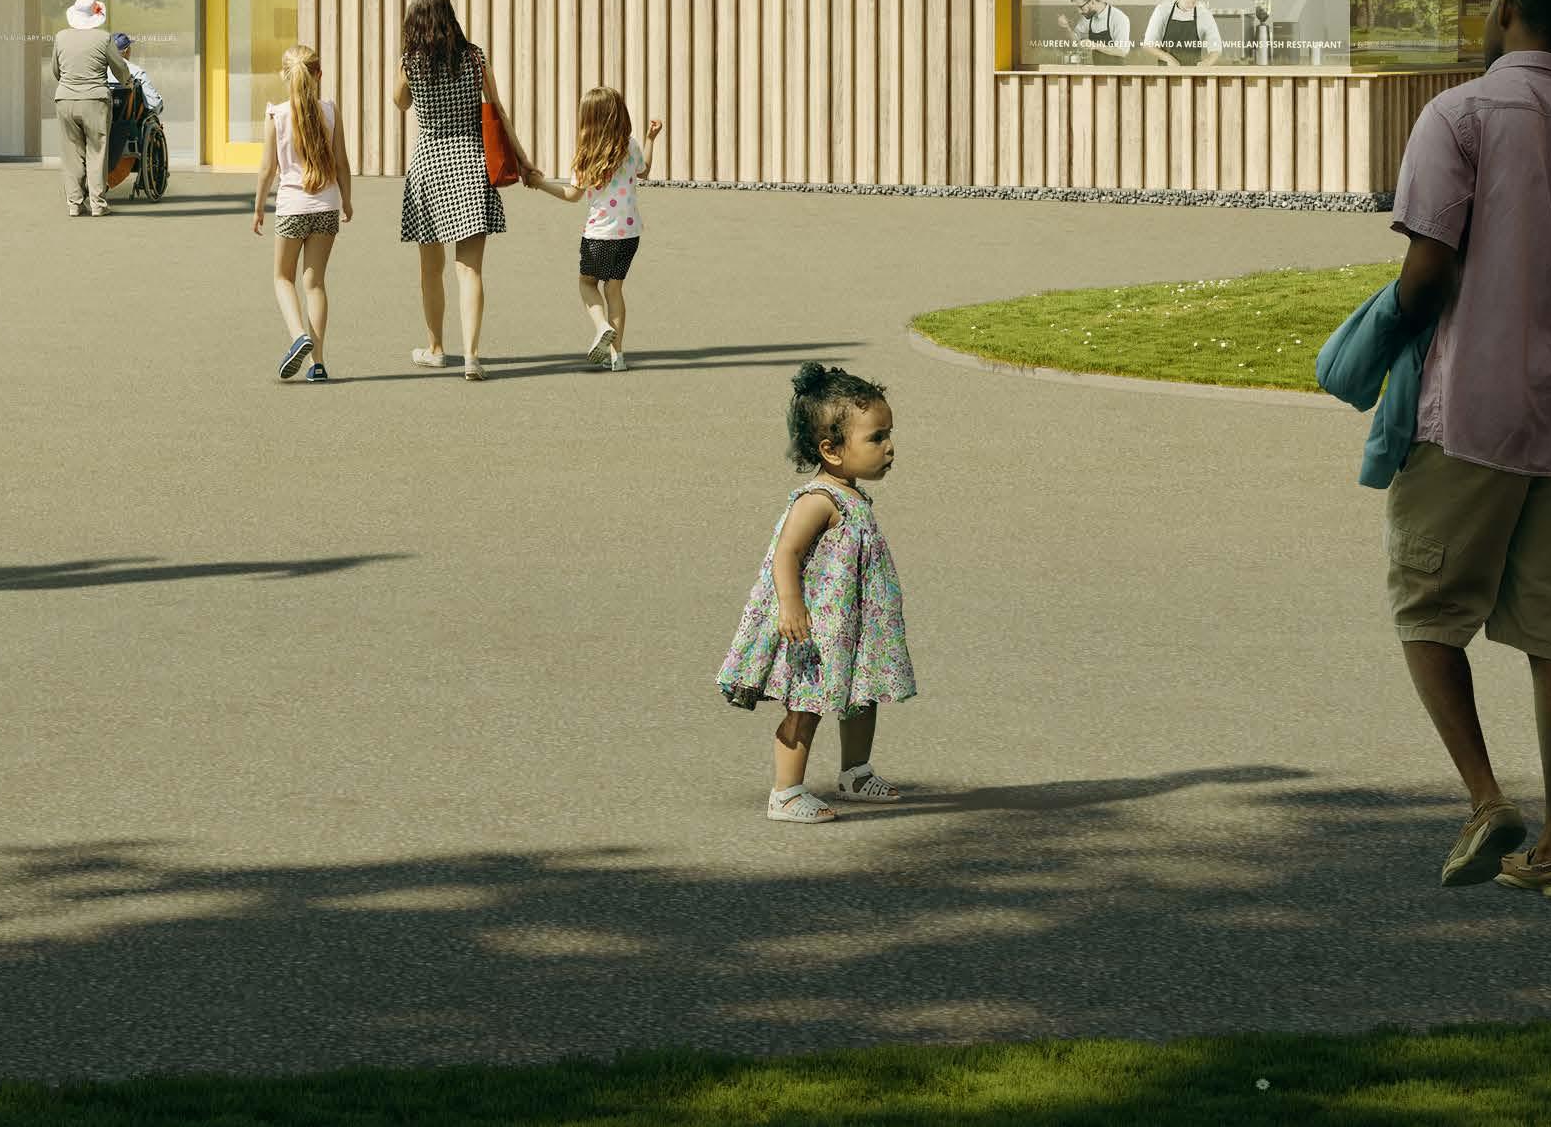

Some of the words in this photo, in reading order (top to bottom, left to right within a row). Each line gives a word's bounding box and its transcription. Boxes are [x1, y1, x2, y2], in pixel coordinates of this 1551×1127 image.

[1029, 39, 1070, 48] MAUREEN
[1071, 39, 1078, 48] &
[1079, 39, 1106, 48] COLIN
[1107, 39, 1135, 48] GREEN
[1147, 40, 1174, 48] DAVID
[1175, 40, 1183, 48] A
[1183, 40, 1209, 48] WEBB
[1222, 40, 1263, 49] WHELANS
[1266, 40, 1285, 49] FISH
[1286, 40, 1343, 49] RESTAURANT
